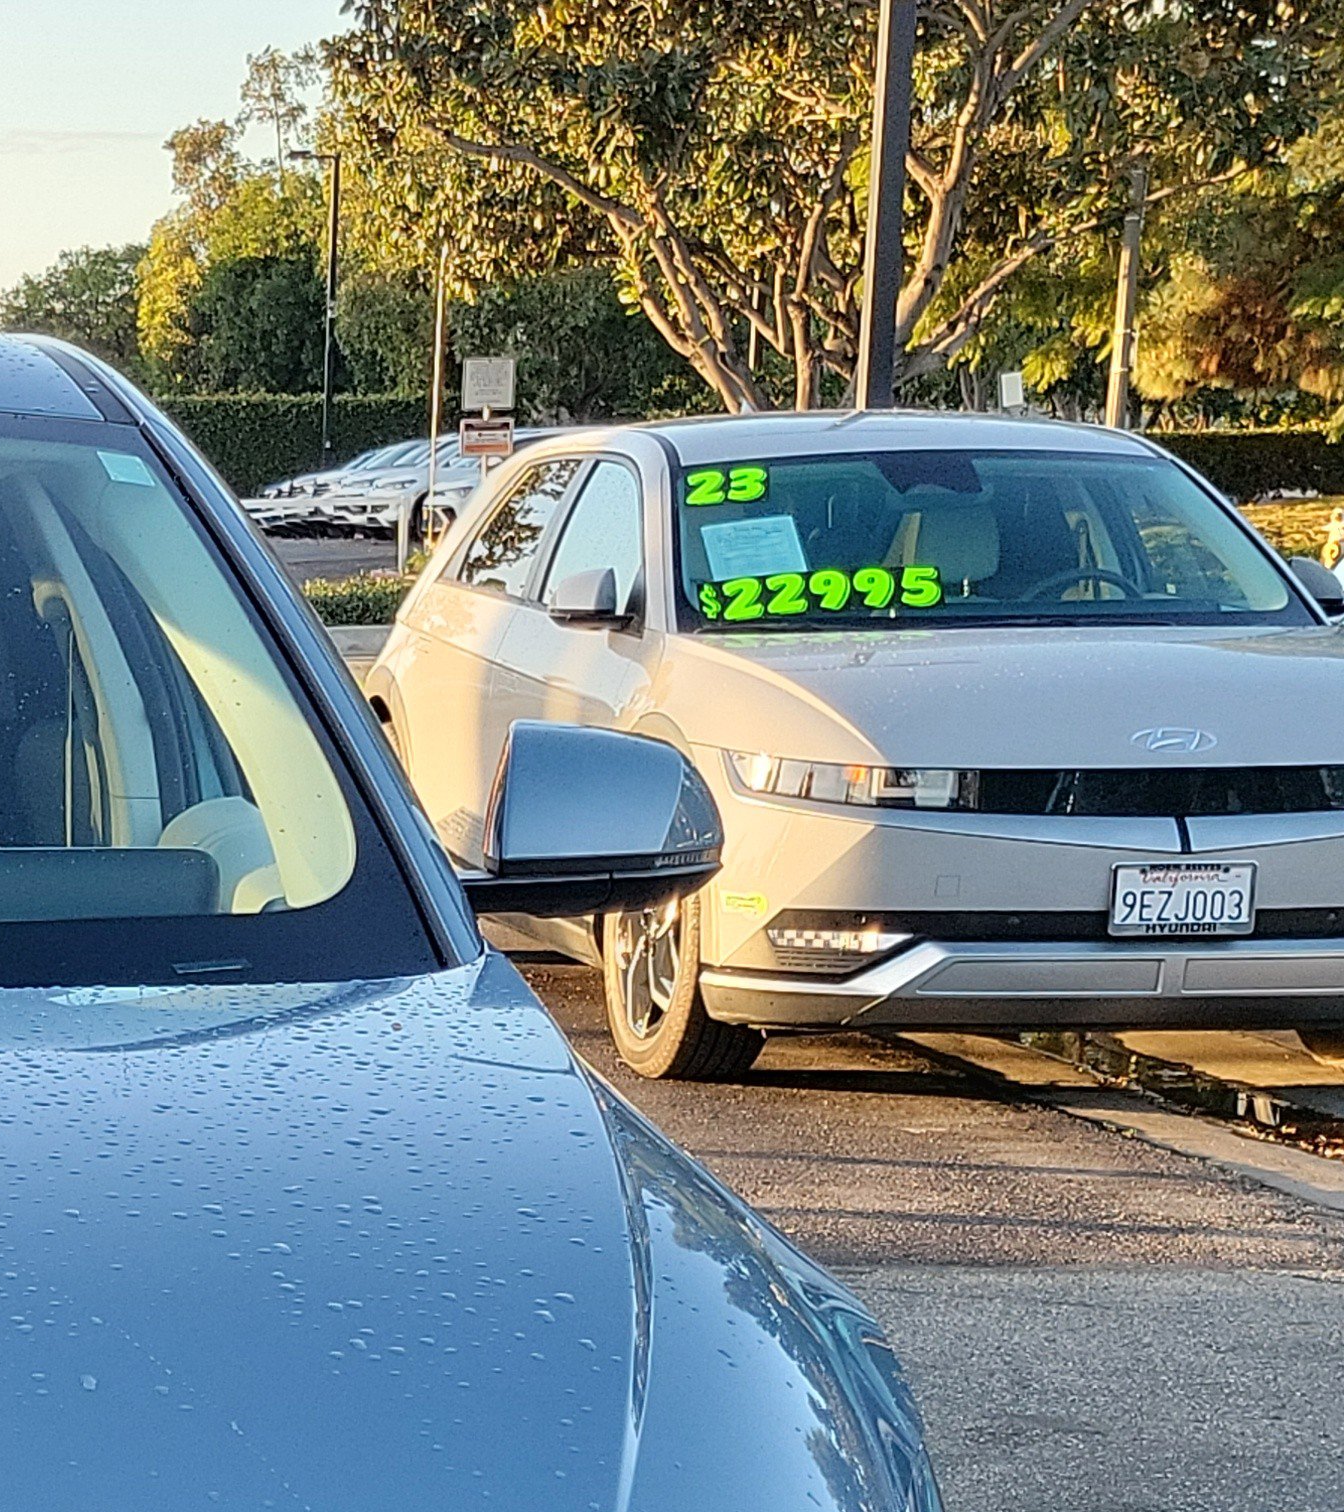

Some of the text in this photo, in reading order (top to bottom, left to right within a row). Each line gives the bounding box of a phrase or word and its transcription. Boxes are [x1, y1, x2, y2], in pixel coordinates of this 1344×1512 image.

[685, 466, 768, 505] 23
[699, 566, 942, 621] $22995
[1120, 889, 1244, 922] 9EZJ003
[1145, 922, 1217, 934] HYUNDAI
